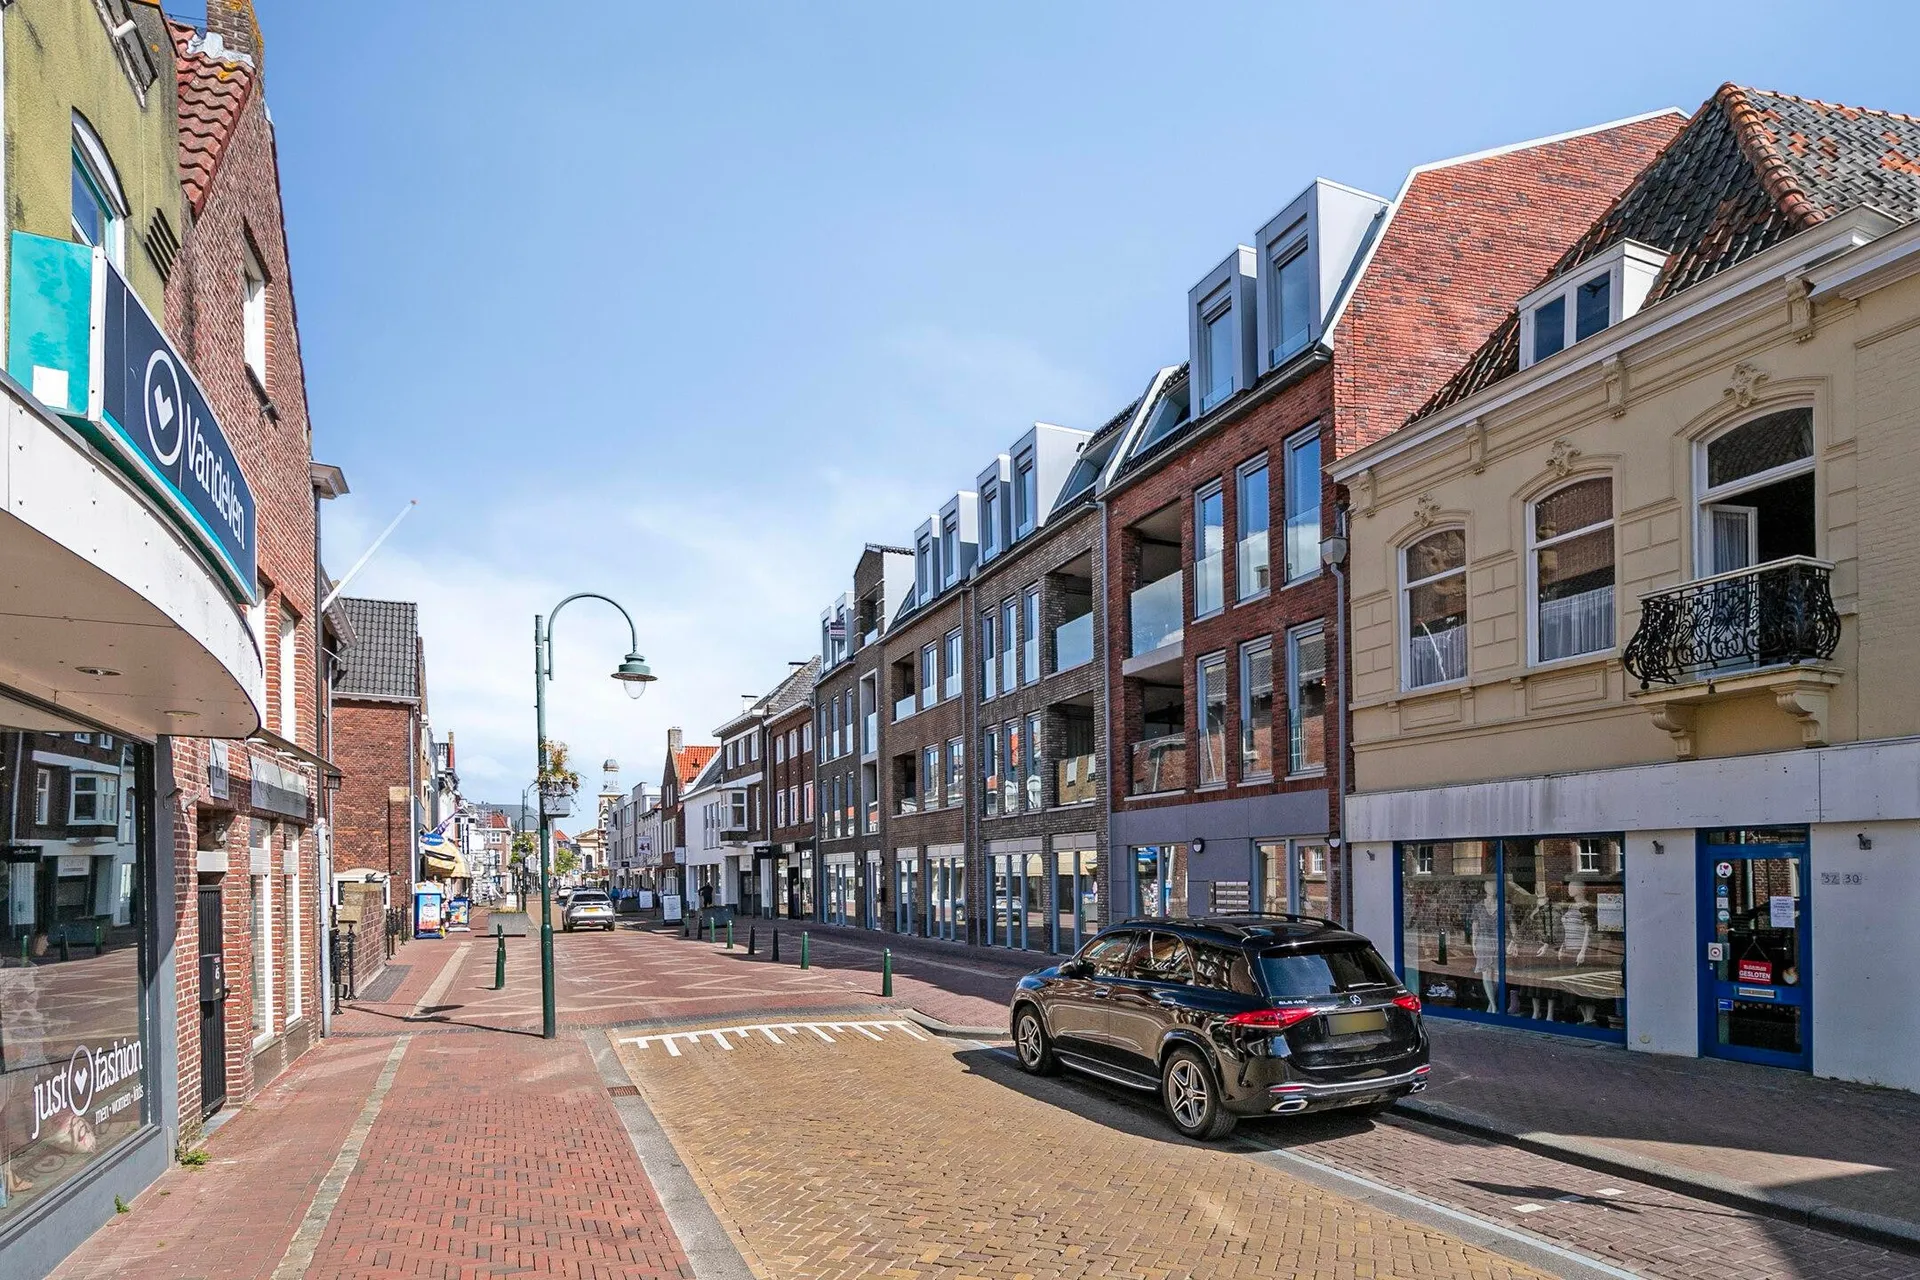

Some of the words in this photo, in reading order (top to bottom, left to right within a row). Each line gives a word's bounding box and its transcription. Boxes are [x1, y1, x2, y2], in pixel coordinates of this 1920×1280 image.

[1845, 874, 1860, 884] 30
[1739, 970, 1771, 980] GESLOTEN
[32, 1065, 68, 1140] just
[95, 1038, 143, 1092] fashion
